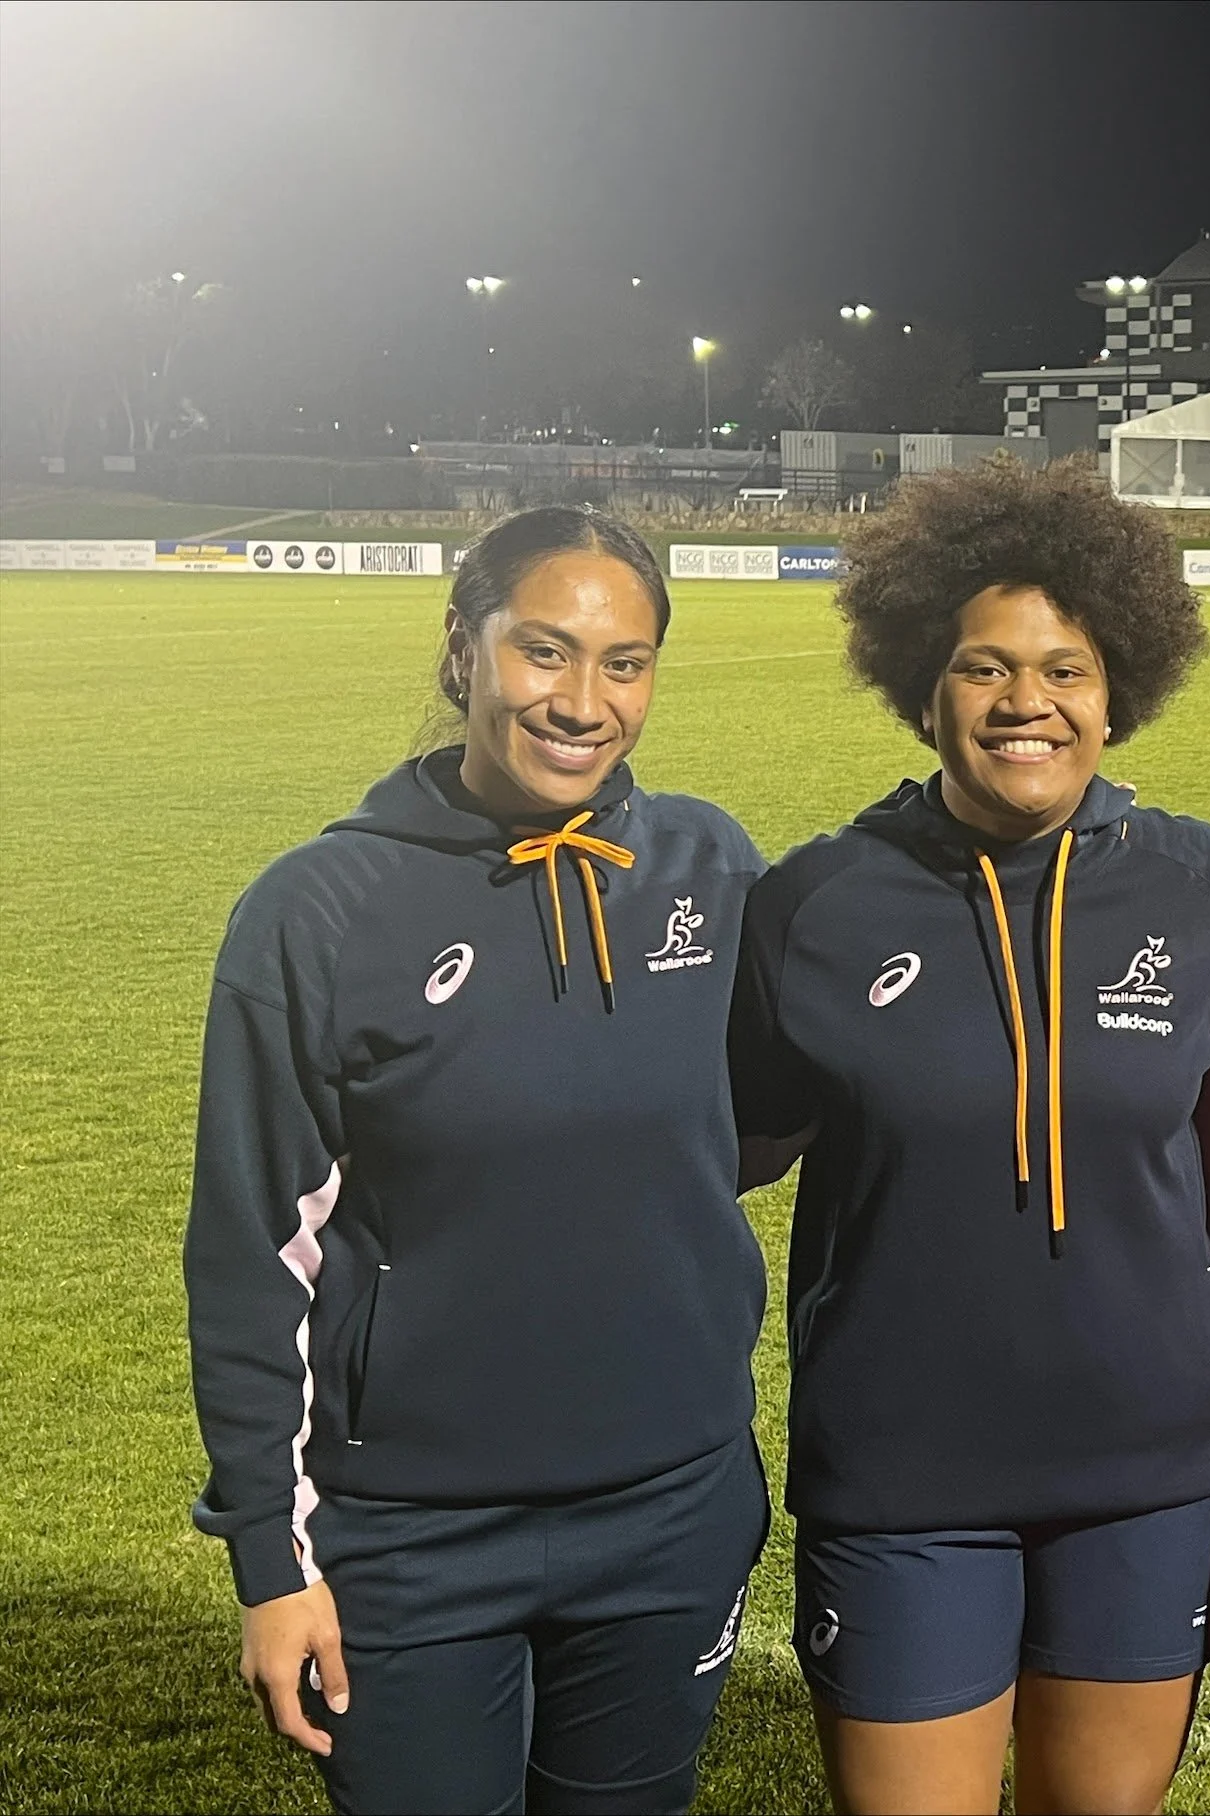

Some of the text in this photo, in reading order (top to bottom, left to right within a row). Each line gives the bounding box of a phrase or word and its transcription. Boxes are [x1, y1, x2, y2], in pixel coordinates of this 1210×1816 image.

[360, 545, 418, 573] ARISTOCRAT
[678, 552, 703, 564] NCG
[711, 553, 737, 565] NCG
[745, 553, 772, 566] NCG
[647, 953, 713, 973] Wallaroos
[1098, 991, 1171, 1007] Wallaroos
[1096, 1012, 1174, 1037] Buildcorp
